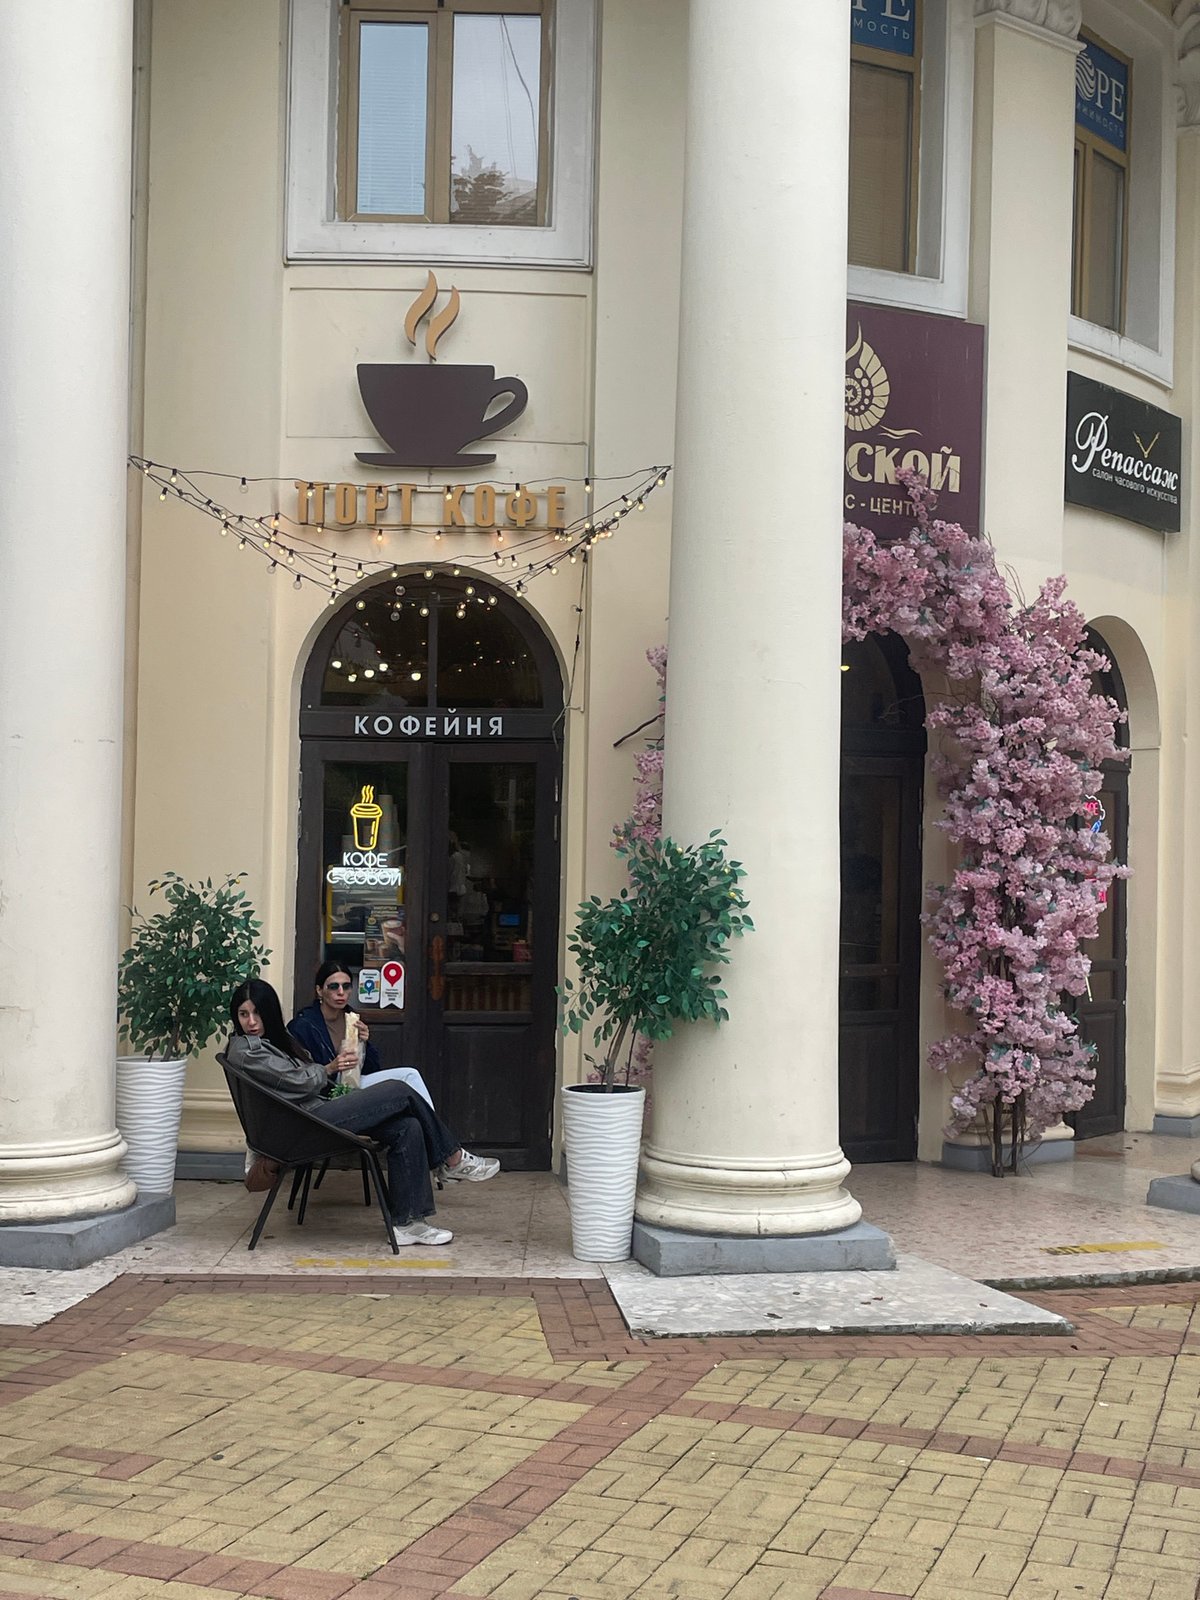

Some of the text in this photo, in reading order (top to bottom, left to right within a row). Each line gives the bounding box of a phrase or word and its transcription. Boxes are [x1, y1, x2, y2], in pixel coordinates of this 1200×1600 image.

[845, 442, 961, 493] СКОЙ
[1071, 411, 1179, 491] Репассаж
[294, 481, 566, 529] ПОРТ КОФЕ
[1092, 468, 1178, 505] салон часового искусства
[354, 707, 504, 736] КОФЕЙНЯ
[343, 850, 389, 869] КОФЕ
